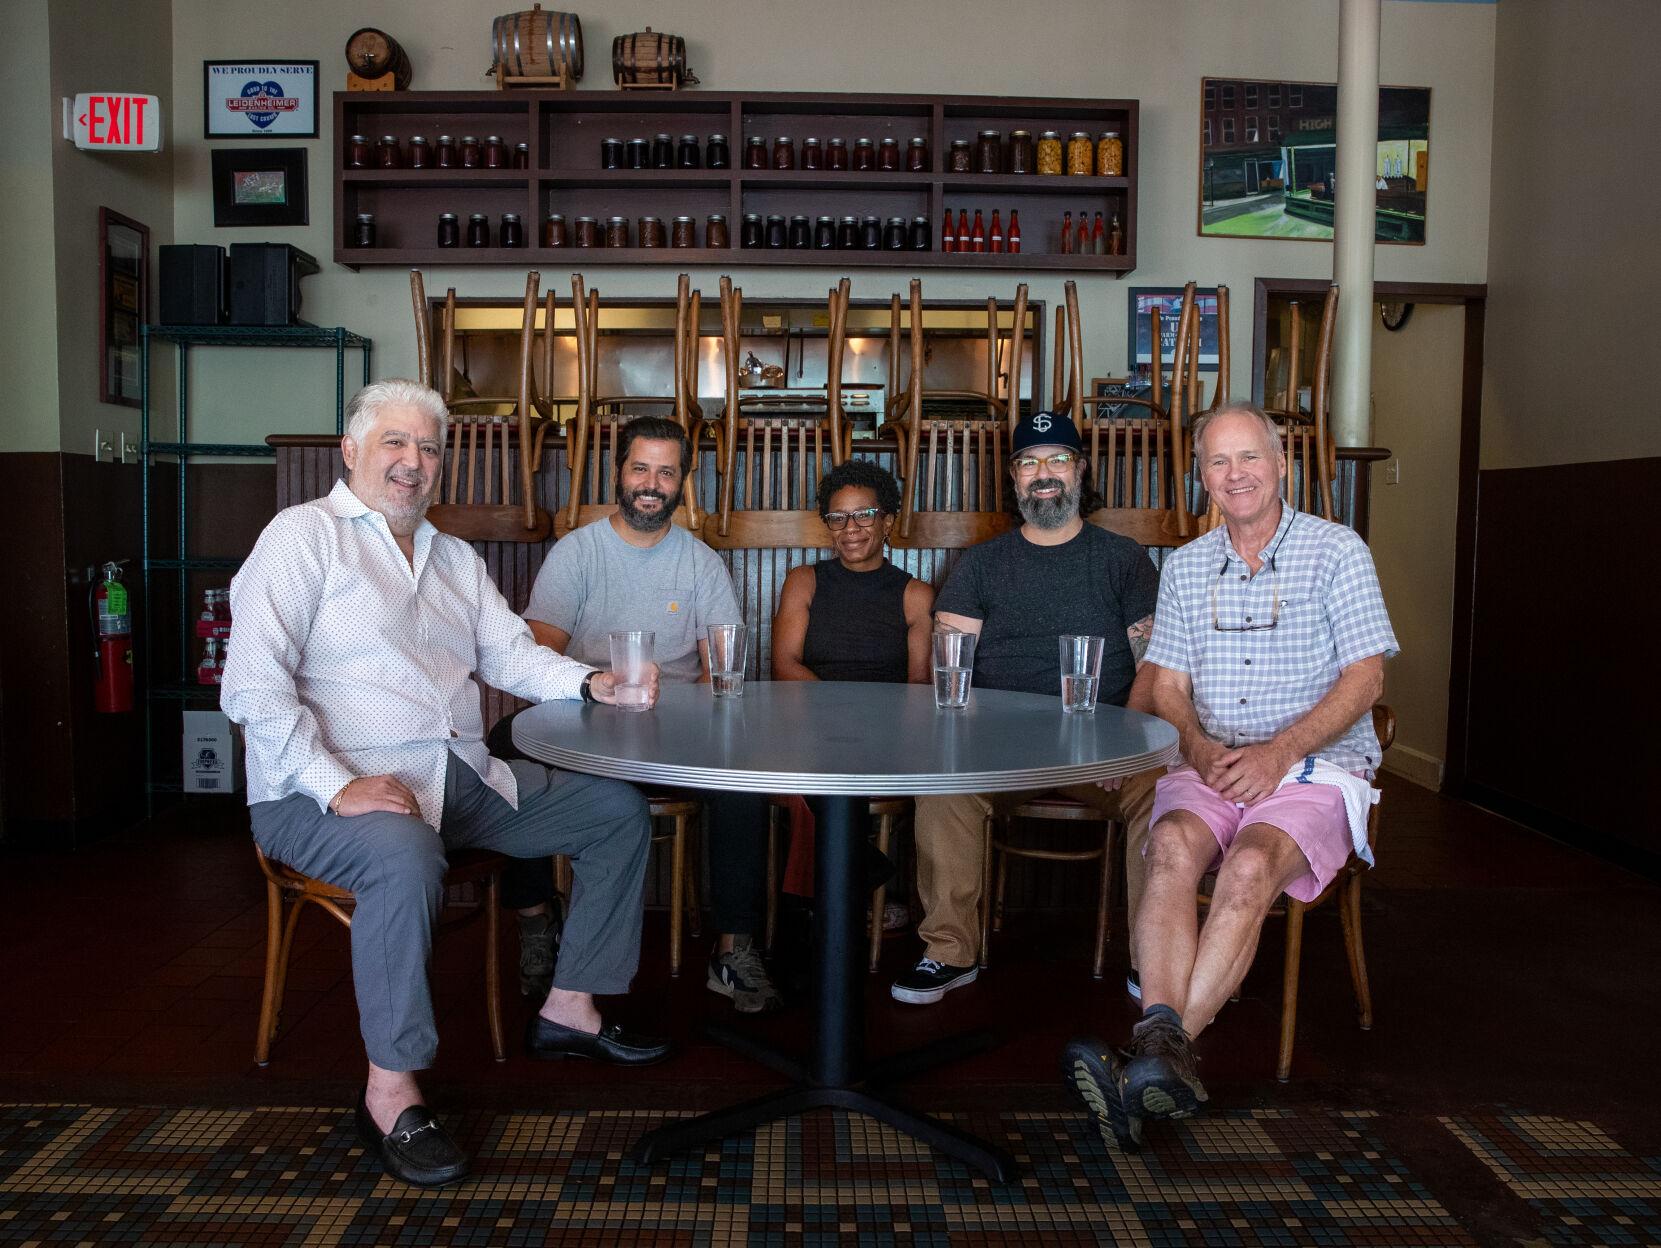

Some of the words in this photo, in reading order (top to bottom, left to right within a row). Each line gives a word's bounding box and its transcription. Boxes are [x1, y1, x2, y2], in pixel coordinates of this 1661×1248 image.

[212, 67, 229, 75] WE
[280, 66, 313, 74] SERVE
[228, 99, 296, 107] LEIDENHEIMER
[89, 96, 148, 144] EXIT
[1299, 118, 1332, 130] HIGH
